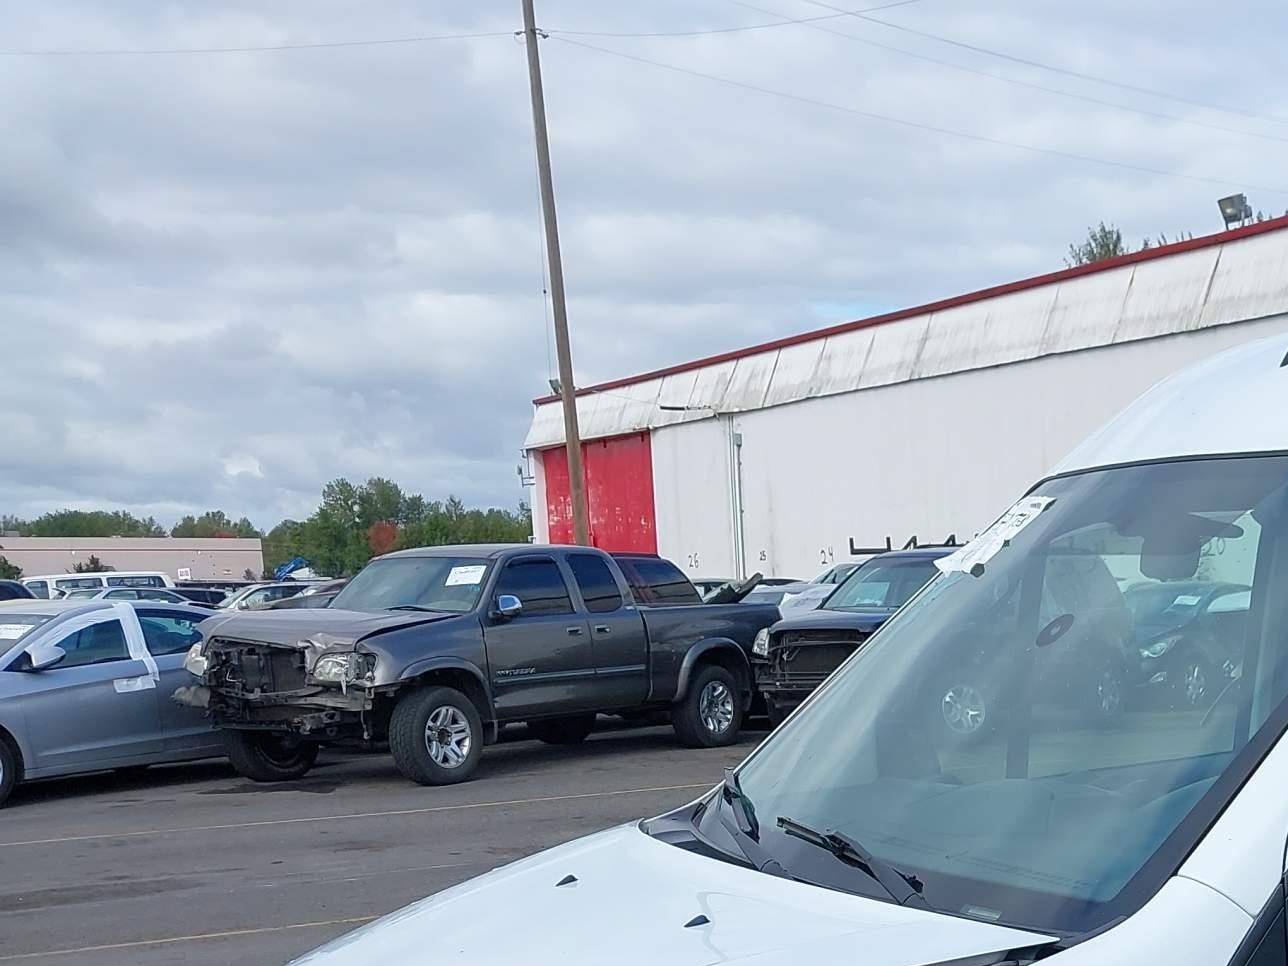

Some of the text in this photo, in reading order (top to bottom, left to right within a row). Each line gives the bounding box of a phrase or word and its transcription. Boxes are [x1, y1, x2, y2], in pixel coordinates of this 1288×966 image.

[688, 552, 699, 568] 26
[759, 550, 767, 561] 25
[820, 547, 834, 565] 24
